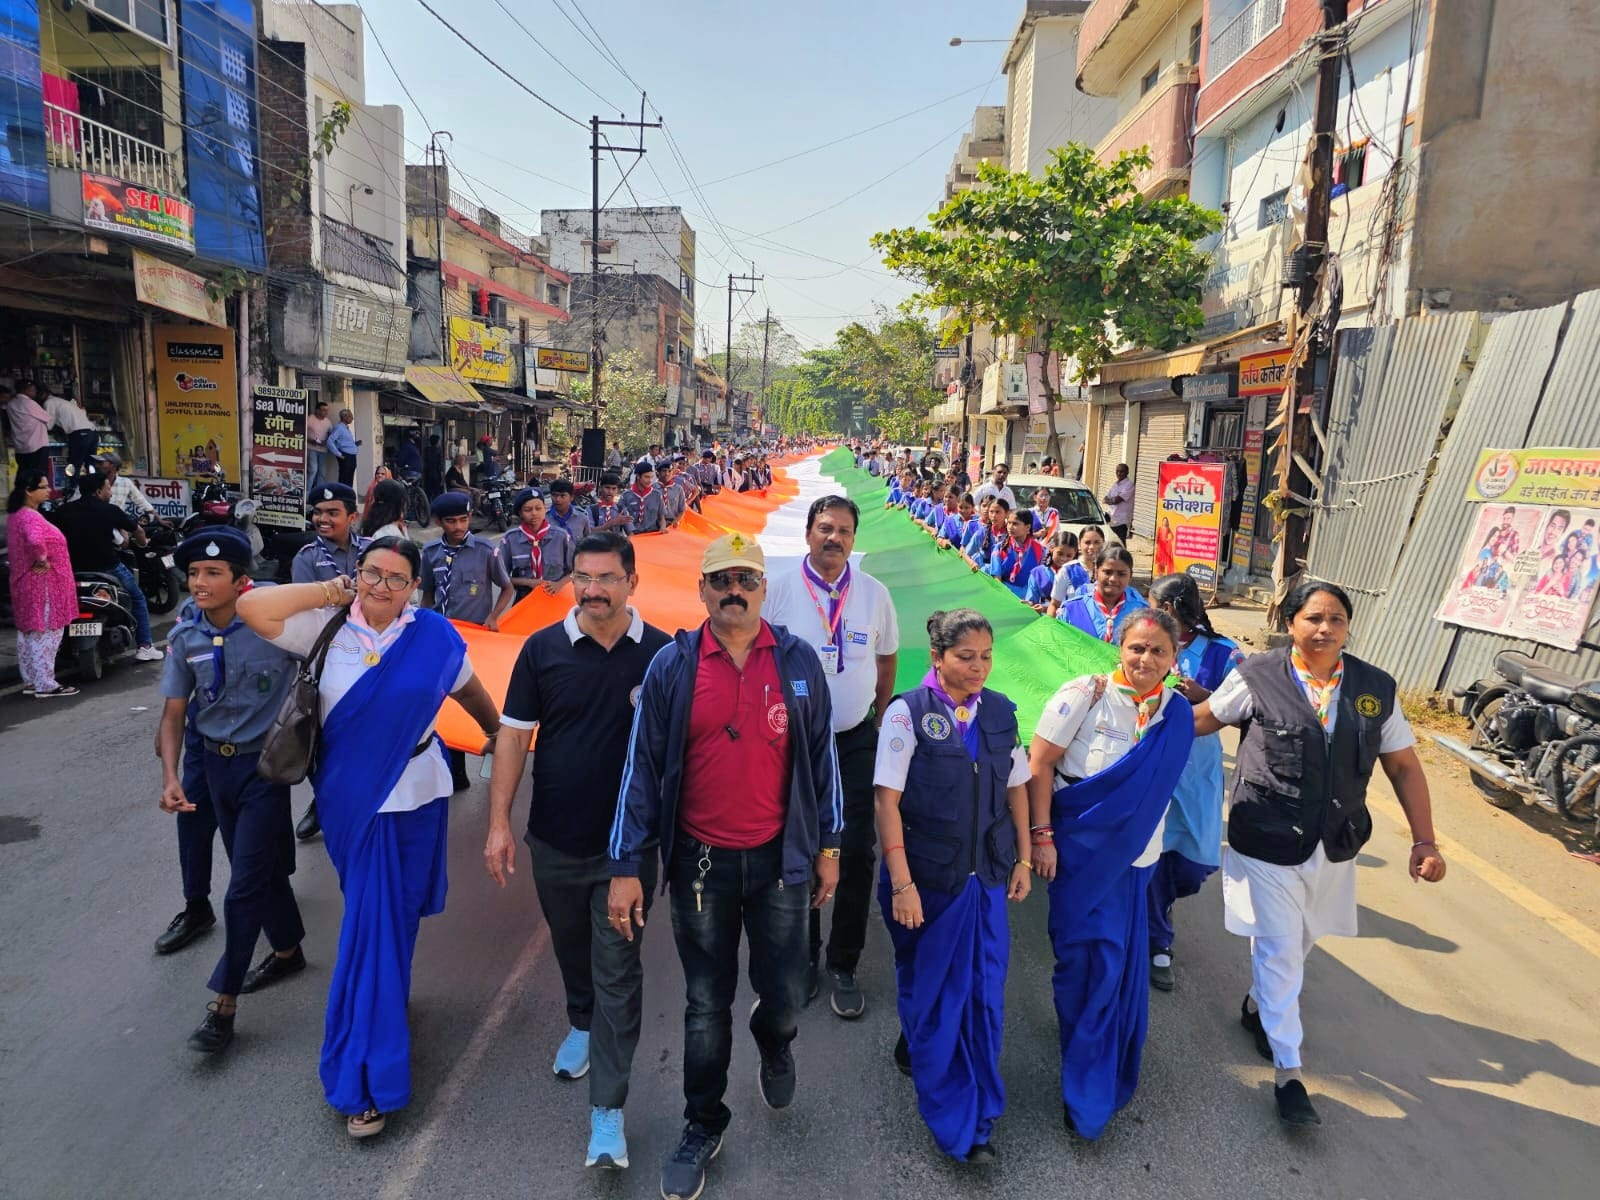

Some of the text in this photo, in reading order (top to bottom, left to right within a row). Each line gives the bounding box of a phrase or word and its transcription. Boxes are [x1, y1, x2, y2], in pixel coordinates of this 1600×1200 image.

[126, 188, 160, 212] SEA
[115, 213, 139, 226] Birds,
[1198, 377, 1227, 397] Collections
[164, 401, 204, 409] UNLIMITED
[276, 398, 305, 415] World
[264, 413, 295, 432] रंगीन
[144, 480, 182, 500] कापी
[1162, 494, 1215, 514] कलेक्शन
